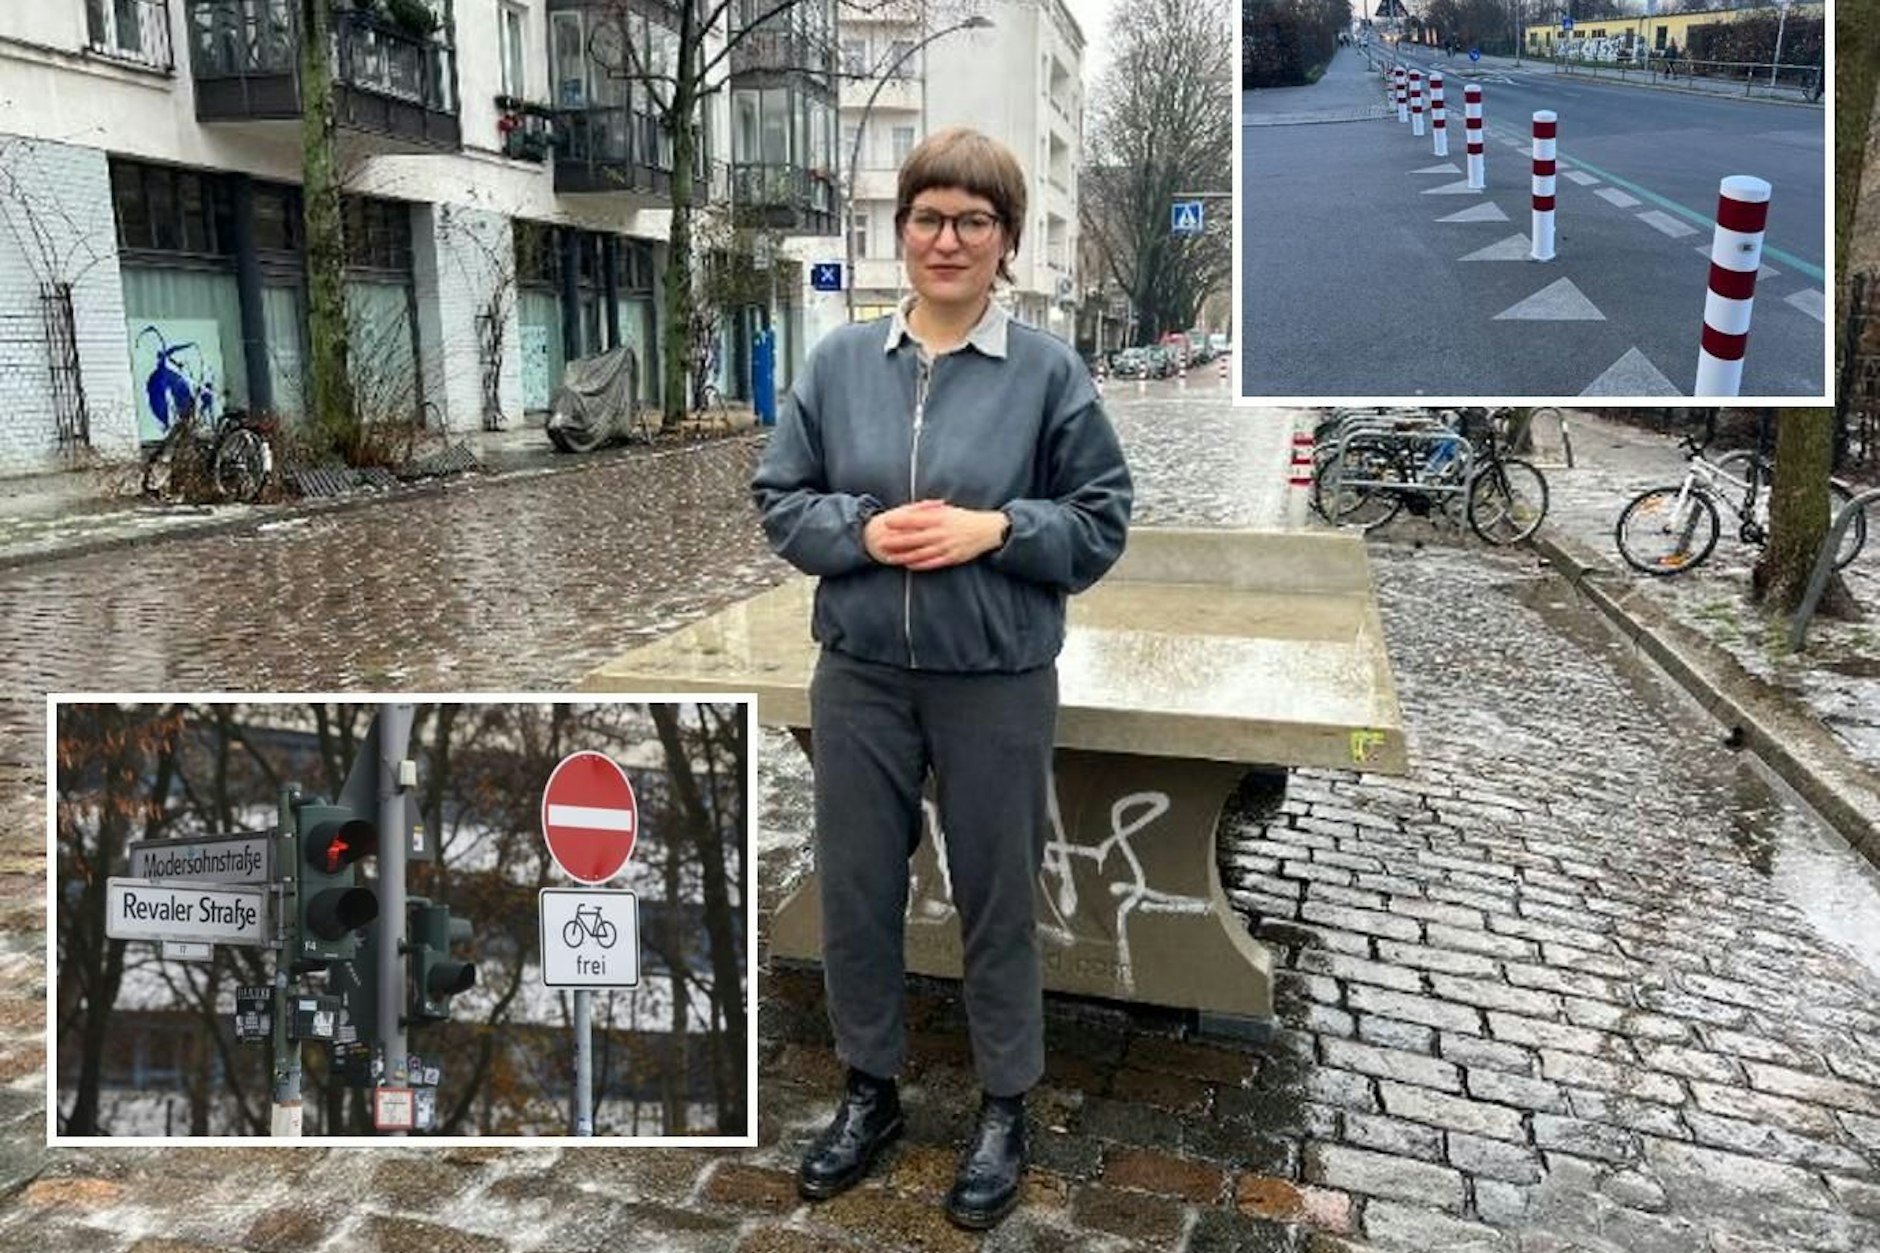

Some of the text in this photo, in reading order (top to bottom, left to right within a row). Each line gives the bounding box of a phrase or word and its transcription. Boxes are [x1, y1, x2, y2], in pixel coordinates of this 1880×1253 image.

[143, 845, 261, 878] Modersohnstraße
[123, 892, 256, 930] Revaler Straße
[304, 941, 317, 951] F4
[577, 954, 606, 975] frei
